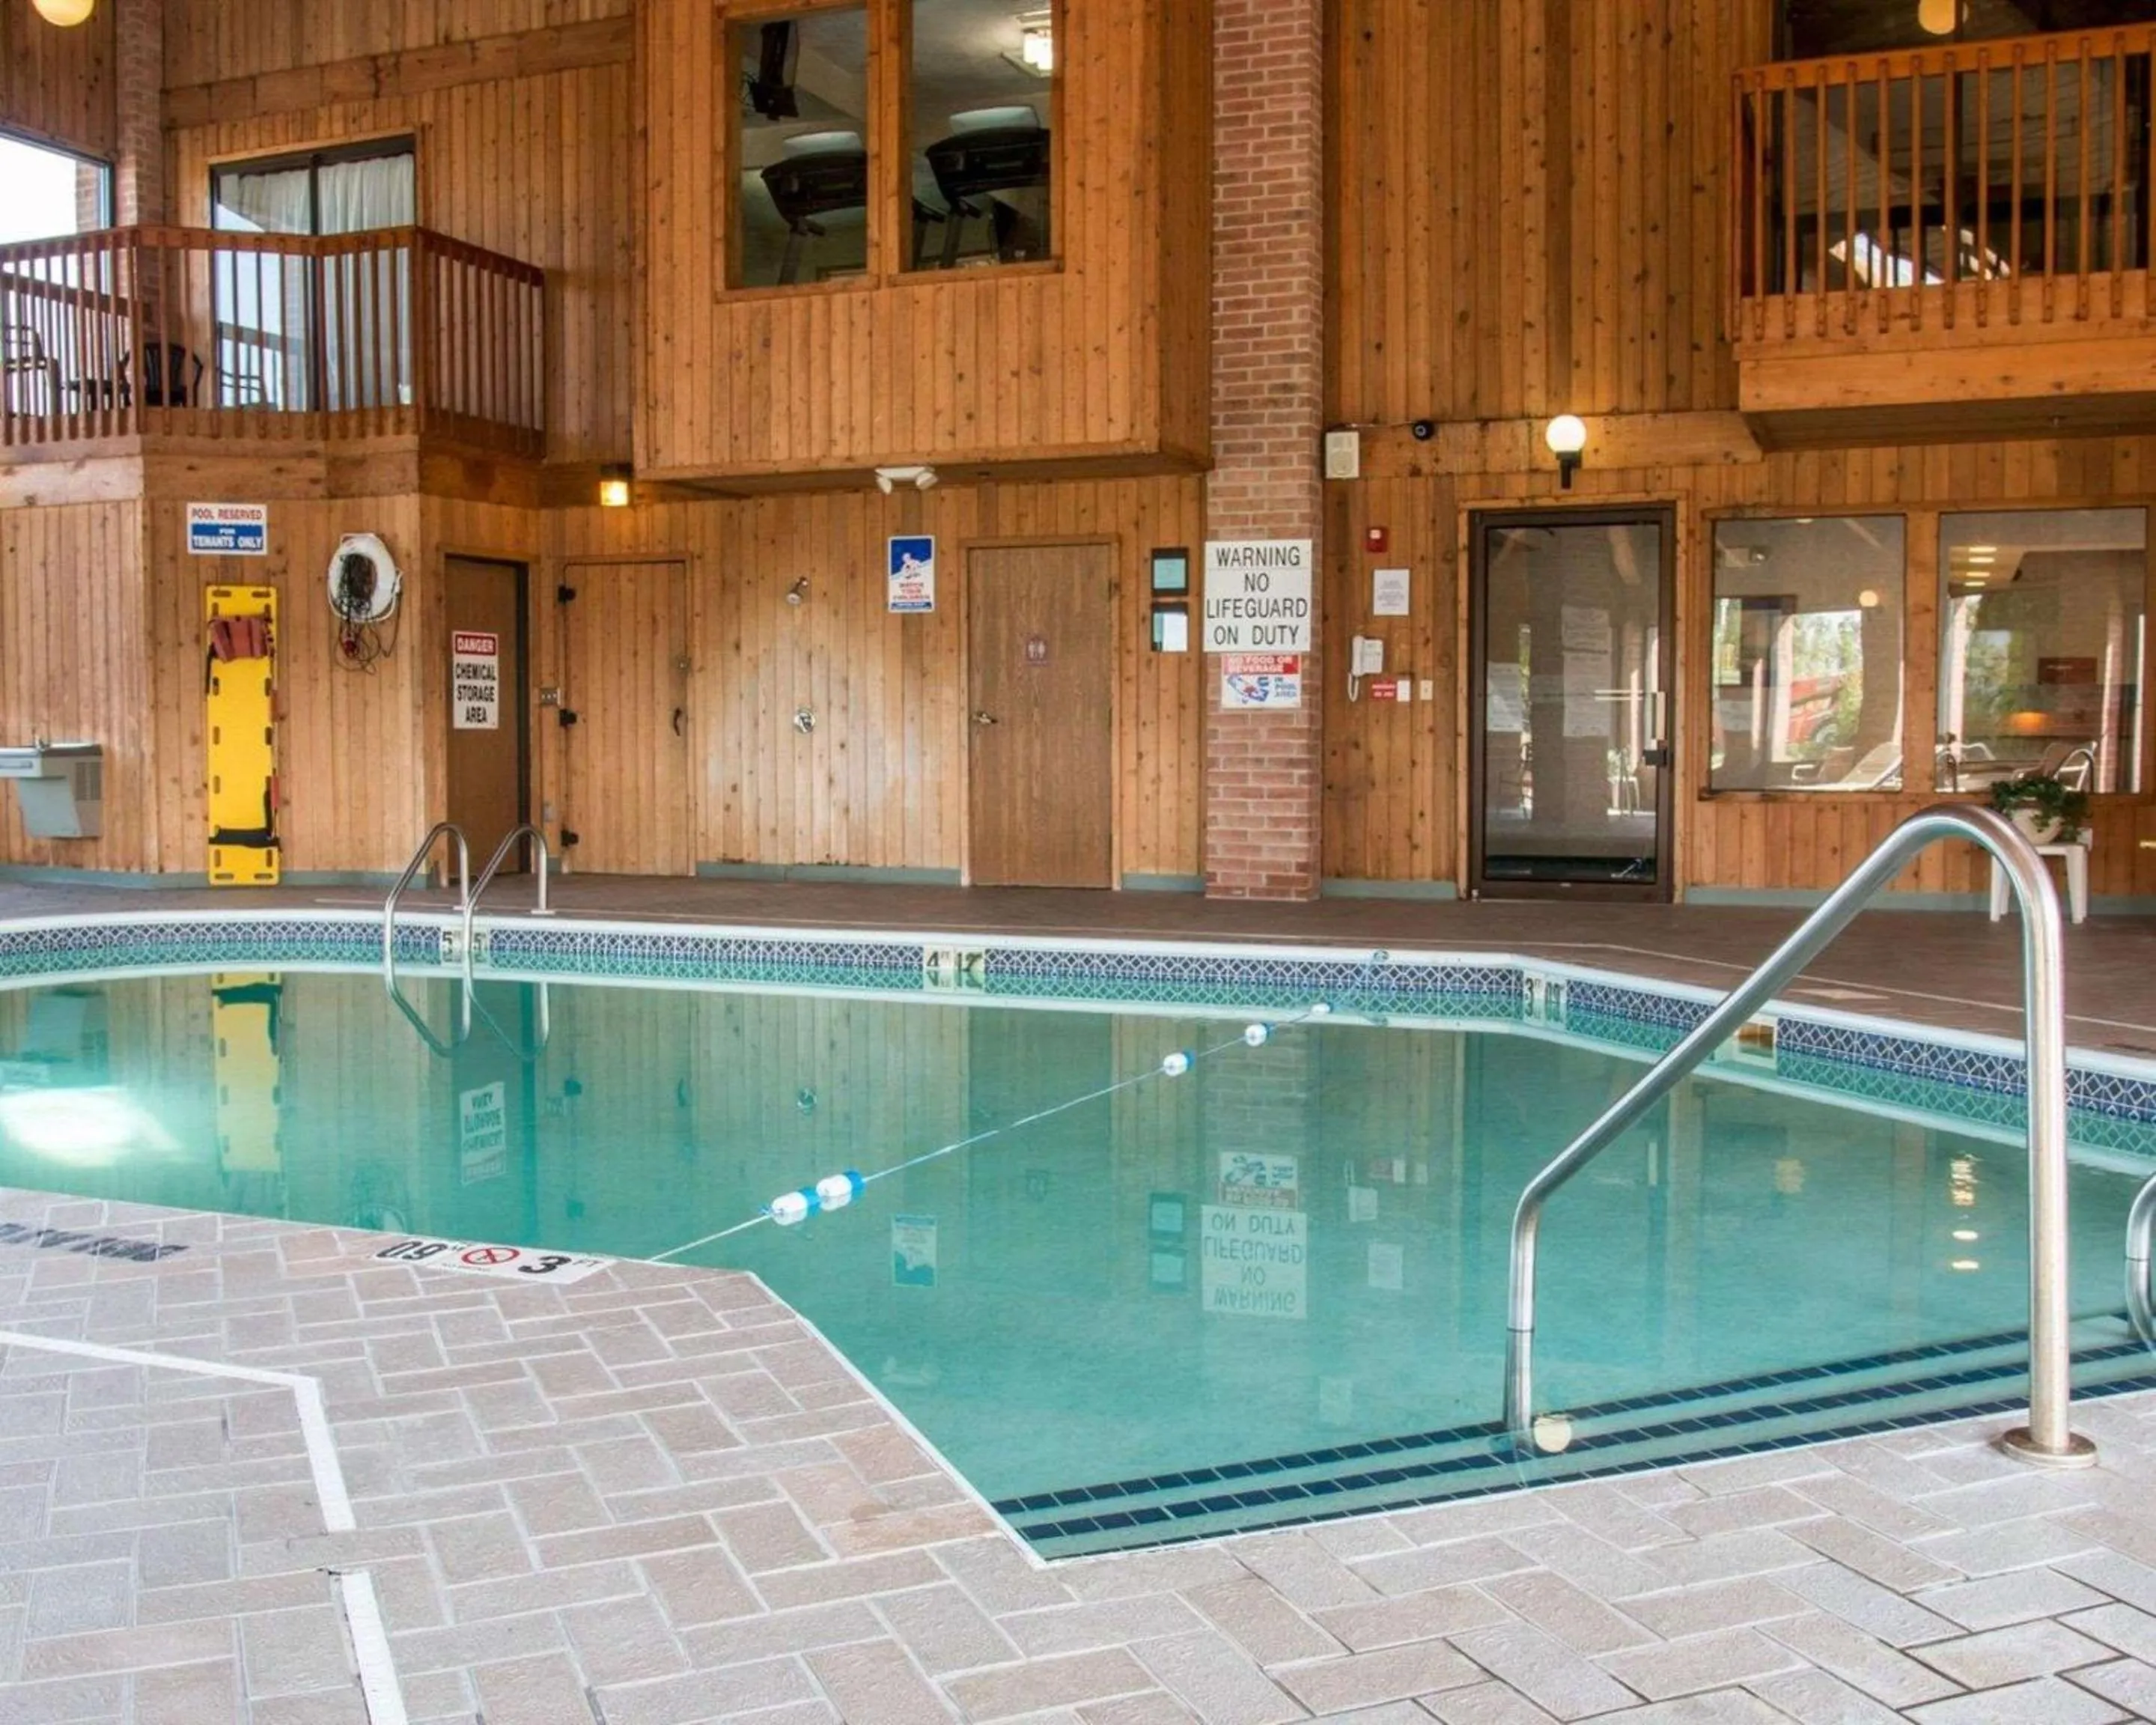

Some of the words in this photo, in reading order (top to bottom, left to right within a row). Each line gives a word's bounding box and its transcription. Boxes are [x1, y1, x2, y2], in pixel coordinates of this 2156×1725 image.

[192, 508, 214, 520] POOL
[218, 509, 262, 520] RESERVED
[192, 536, 234, 548] TENANTS
[237, 536, 263, 548] ONLY
[1216, 546, 1301, 567] WARNING
[1243, 573, 1270, 592] NO
[1206, 597, 1309, 618] LIFEGUARD
[1213, 625, 1238, 645] ON
[1252, 625, 1300, 645] DUTY
[457, 637, 494, 654] DANGER
[455, 663, 496, 681] CHEMICAL
[457, 684, 495, 702] STORAGE
[465, 705, 487, 723] AREA
